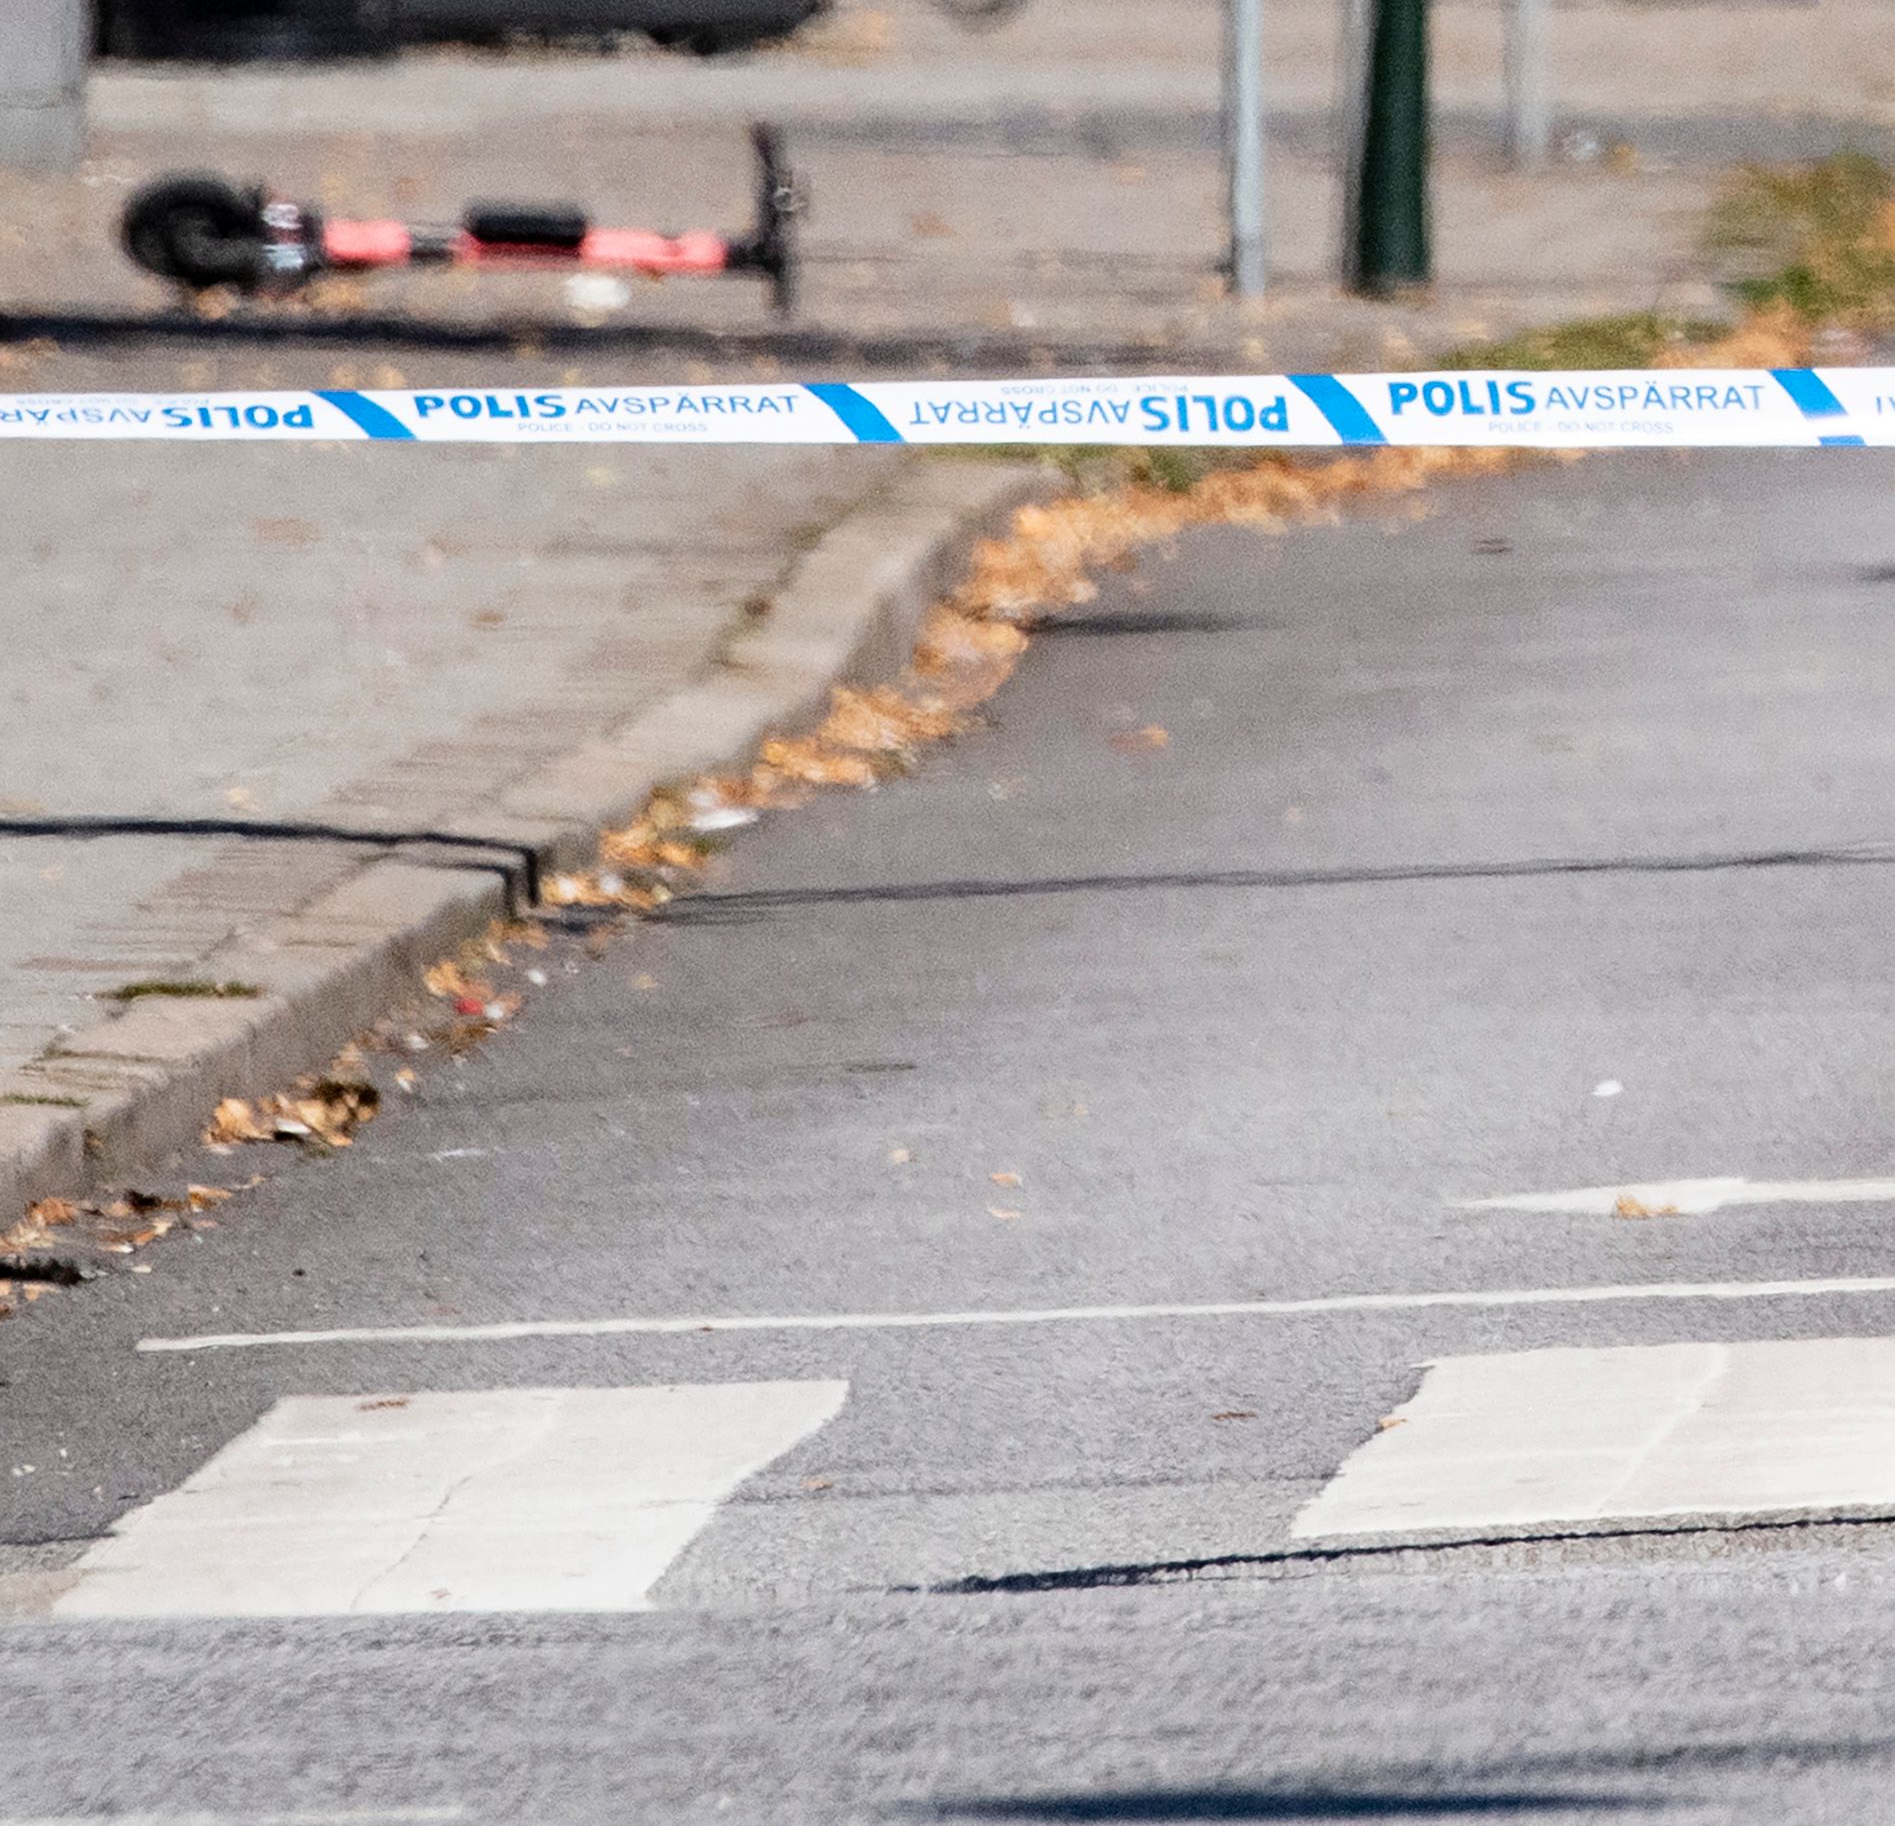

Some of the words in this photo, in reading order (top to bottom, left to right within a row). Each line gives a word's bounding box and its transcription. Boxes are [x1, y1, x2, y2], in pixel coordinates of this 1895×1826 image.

[413, 395, 567, 418] POLIS
[574, 392, 799, 415] AVSPÄRRAT
[1386, 379, 1536, 416] POLIS
[1545, 380, 1765, 411] AVSPÄRRAT
[161, 404, 315, 429] POLIS
[909, 400, 1131, 428] AVSPÄRRAT
[1140, 396, 1290, 431] POLIS
[518, 422, 573, 432] POLICE
[588, 422, 612, 432] DO
[616, 422, 647, 432] NOT
[653, 422, 708, 432] CROSS
[1488, 420, 1545, 434] POLICE
[1557, 421, 1579, 434] DO
[1585, 421, 1614, 434] NOT
[1619, 421, 1674, 434] CROSS
